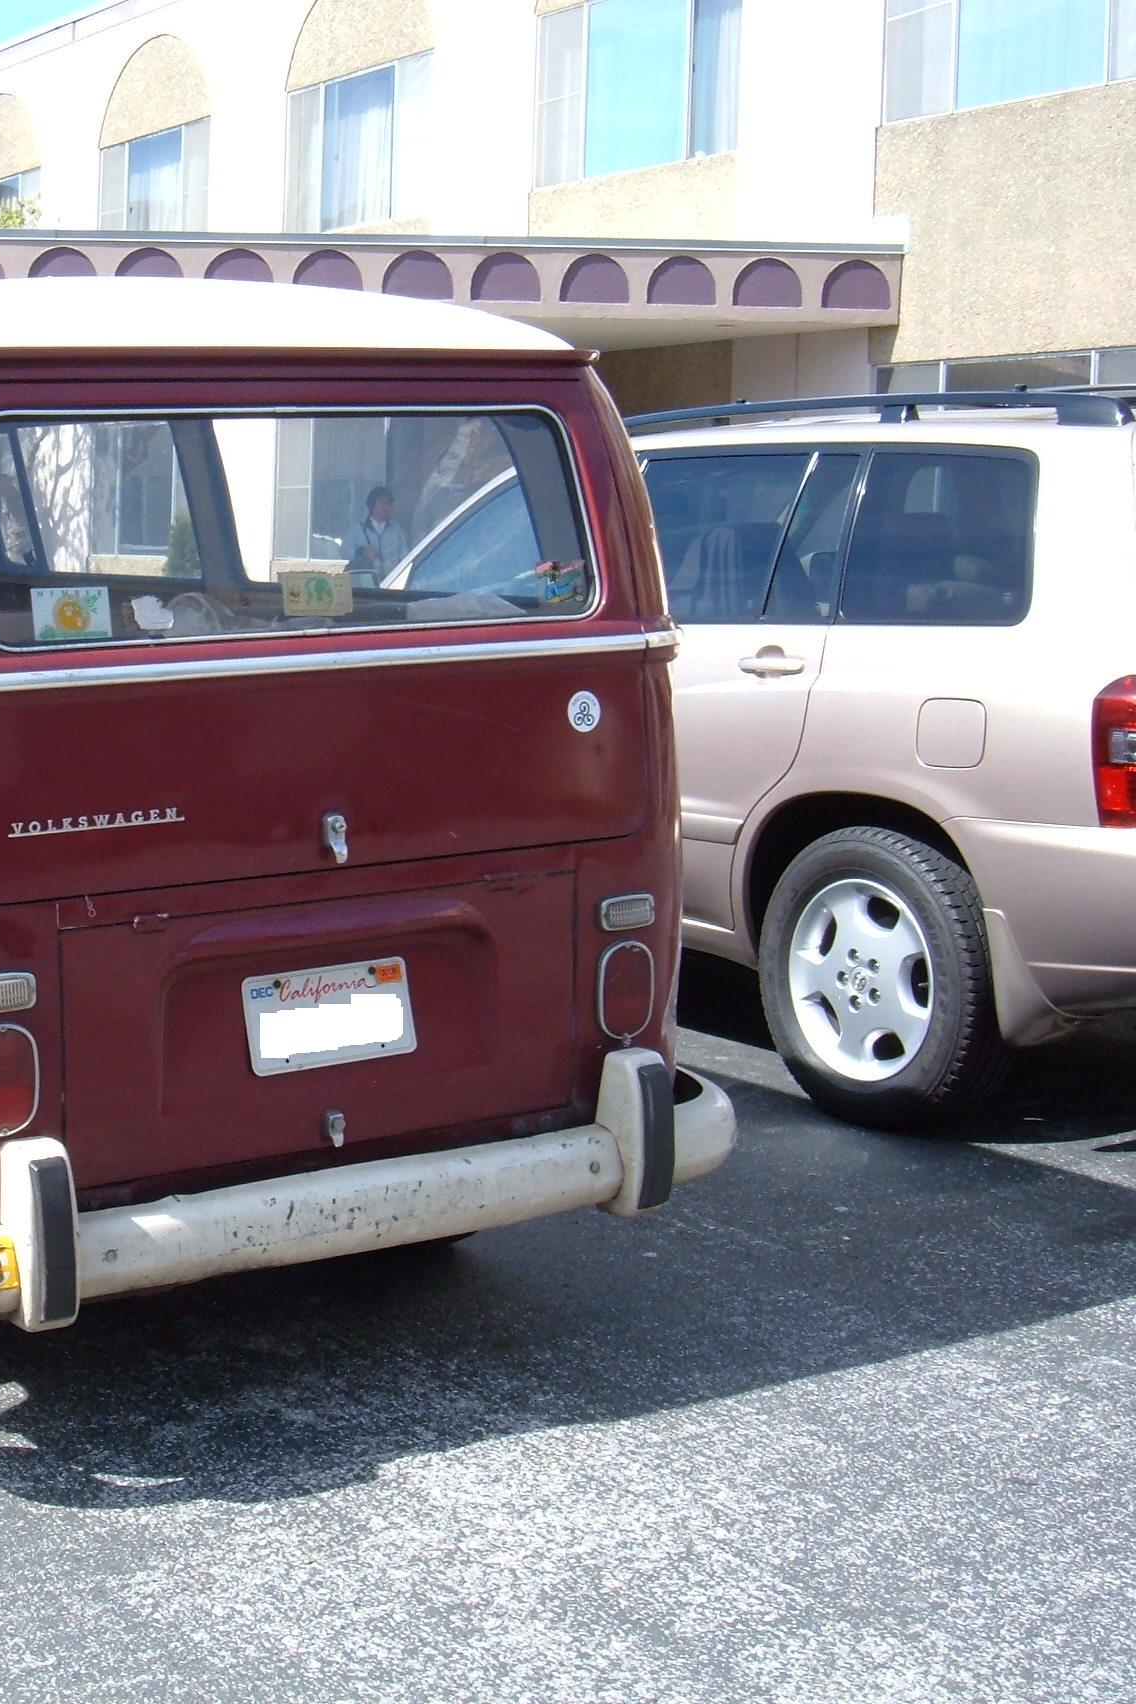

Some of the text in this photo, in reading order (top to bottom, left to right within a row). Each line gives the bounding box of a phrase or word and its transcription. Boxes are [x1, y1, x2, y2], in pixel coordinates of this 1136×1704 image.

[11, 807, 178, 835] VOLKSWAGEN
[250, 974, 376, 1003] DEC California
